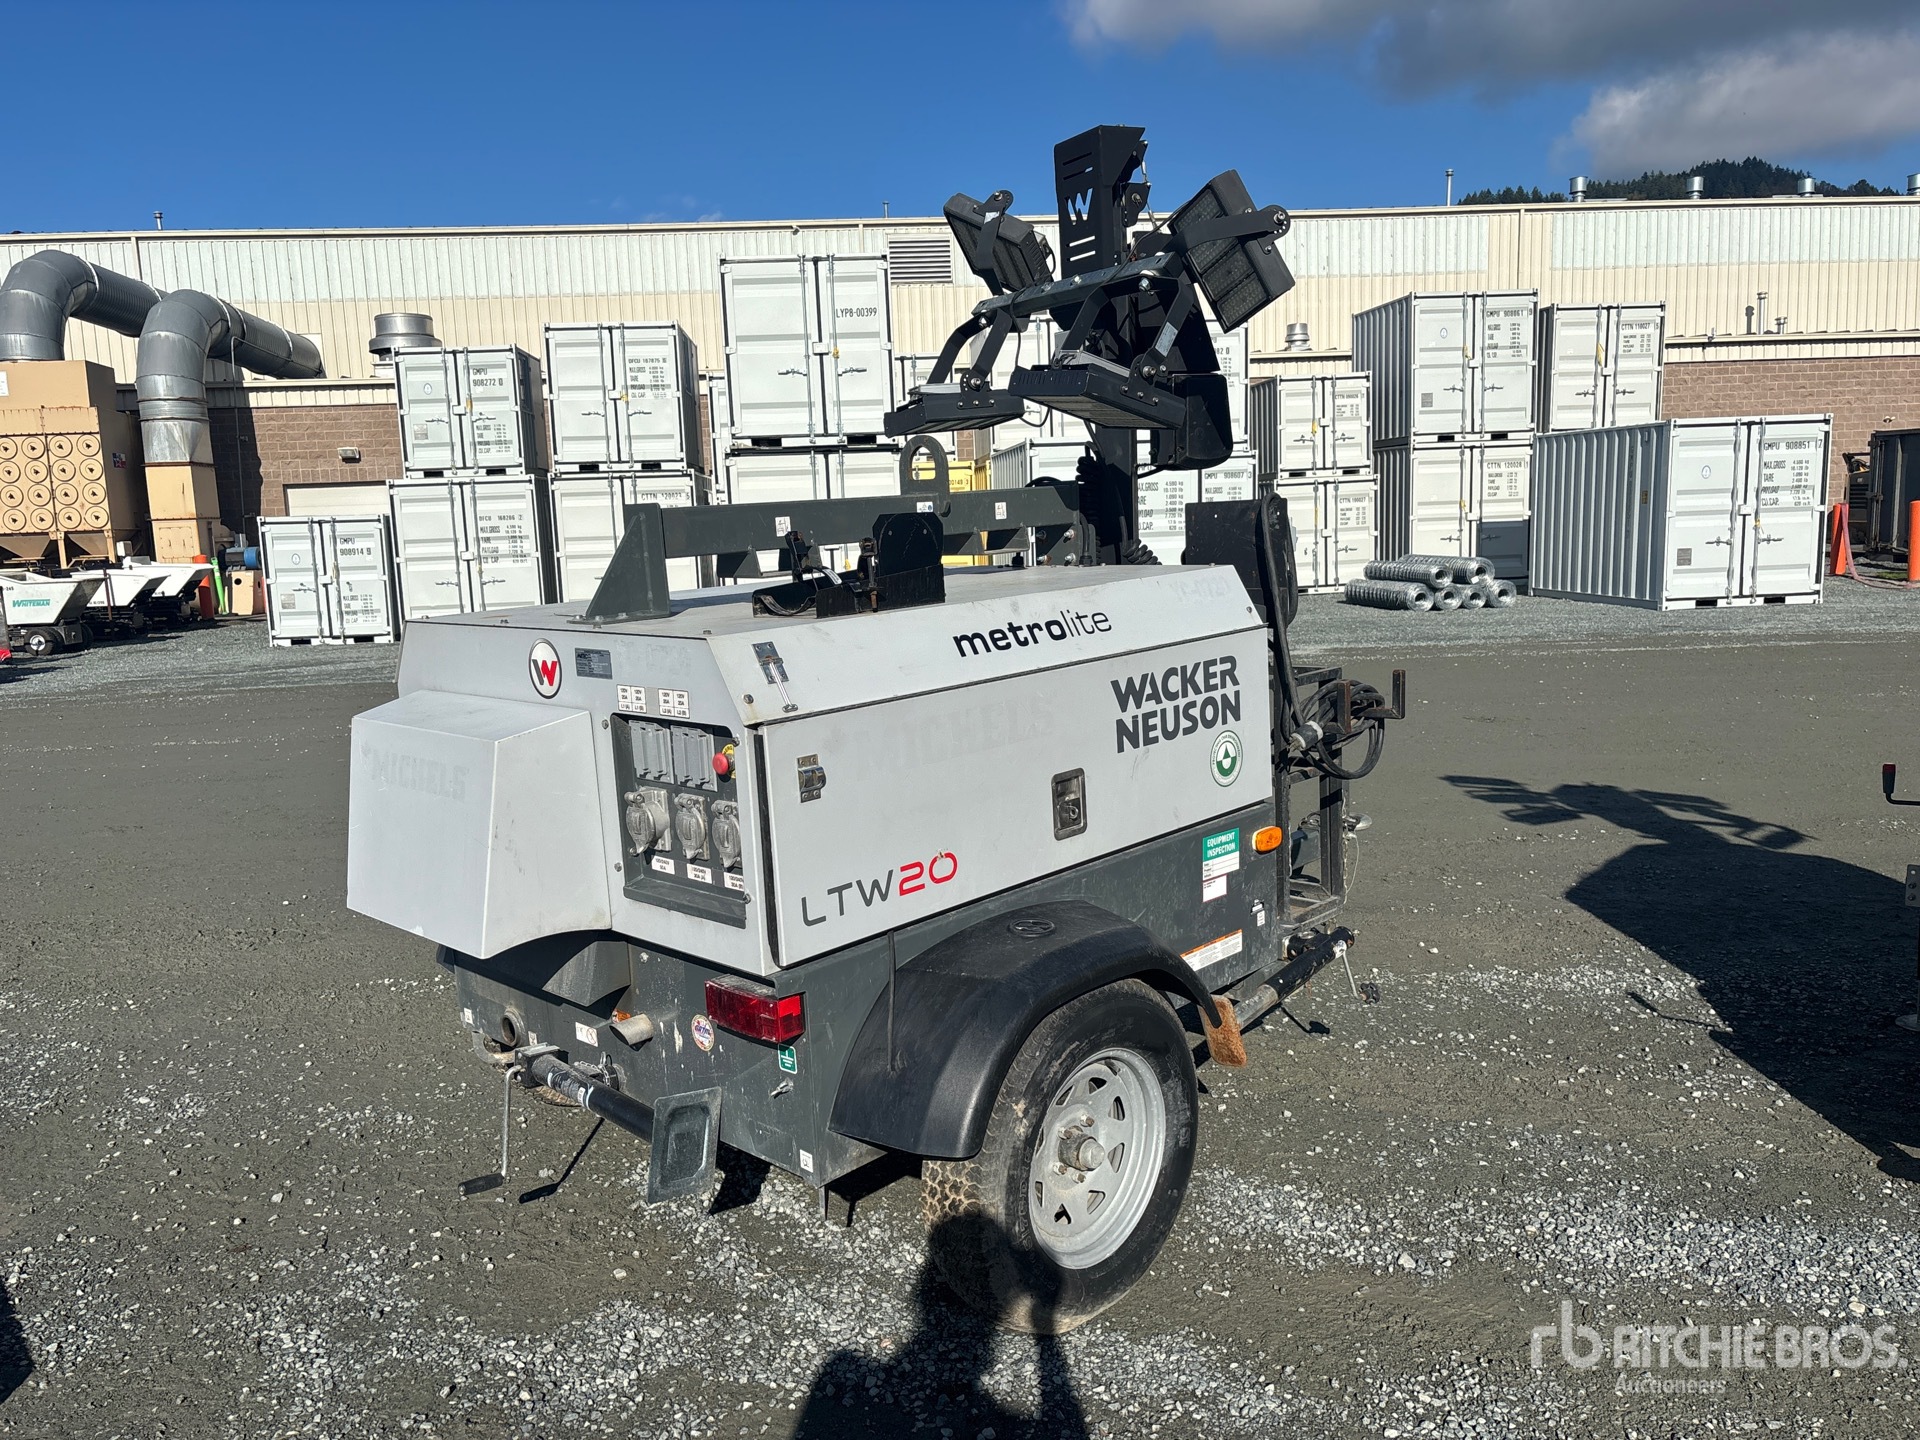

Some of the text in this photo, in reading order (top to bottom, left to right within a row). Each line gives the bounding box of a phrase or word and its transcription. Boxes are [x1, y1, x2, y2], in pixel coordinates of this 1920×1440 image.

[472, 378, 496, 386] 908272
[1764, 442, 1780, 450] GMPU
[1786, 441, 1810, 450] 908851
[1764, 473, 1774, 482] TARE
[952, 609, 1112, 657] metrolite
[1110, 654, 1240, 713] WACKER
[1115, 690, 1241, 753] NEUSON
[1207, 832, 1235, 847] EQUIPMENT
[1207, 842, 1236, 858] INSPECTION
[800, 850, 958, 928] LTW20
